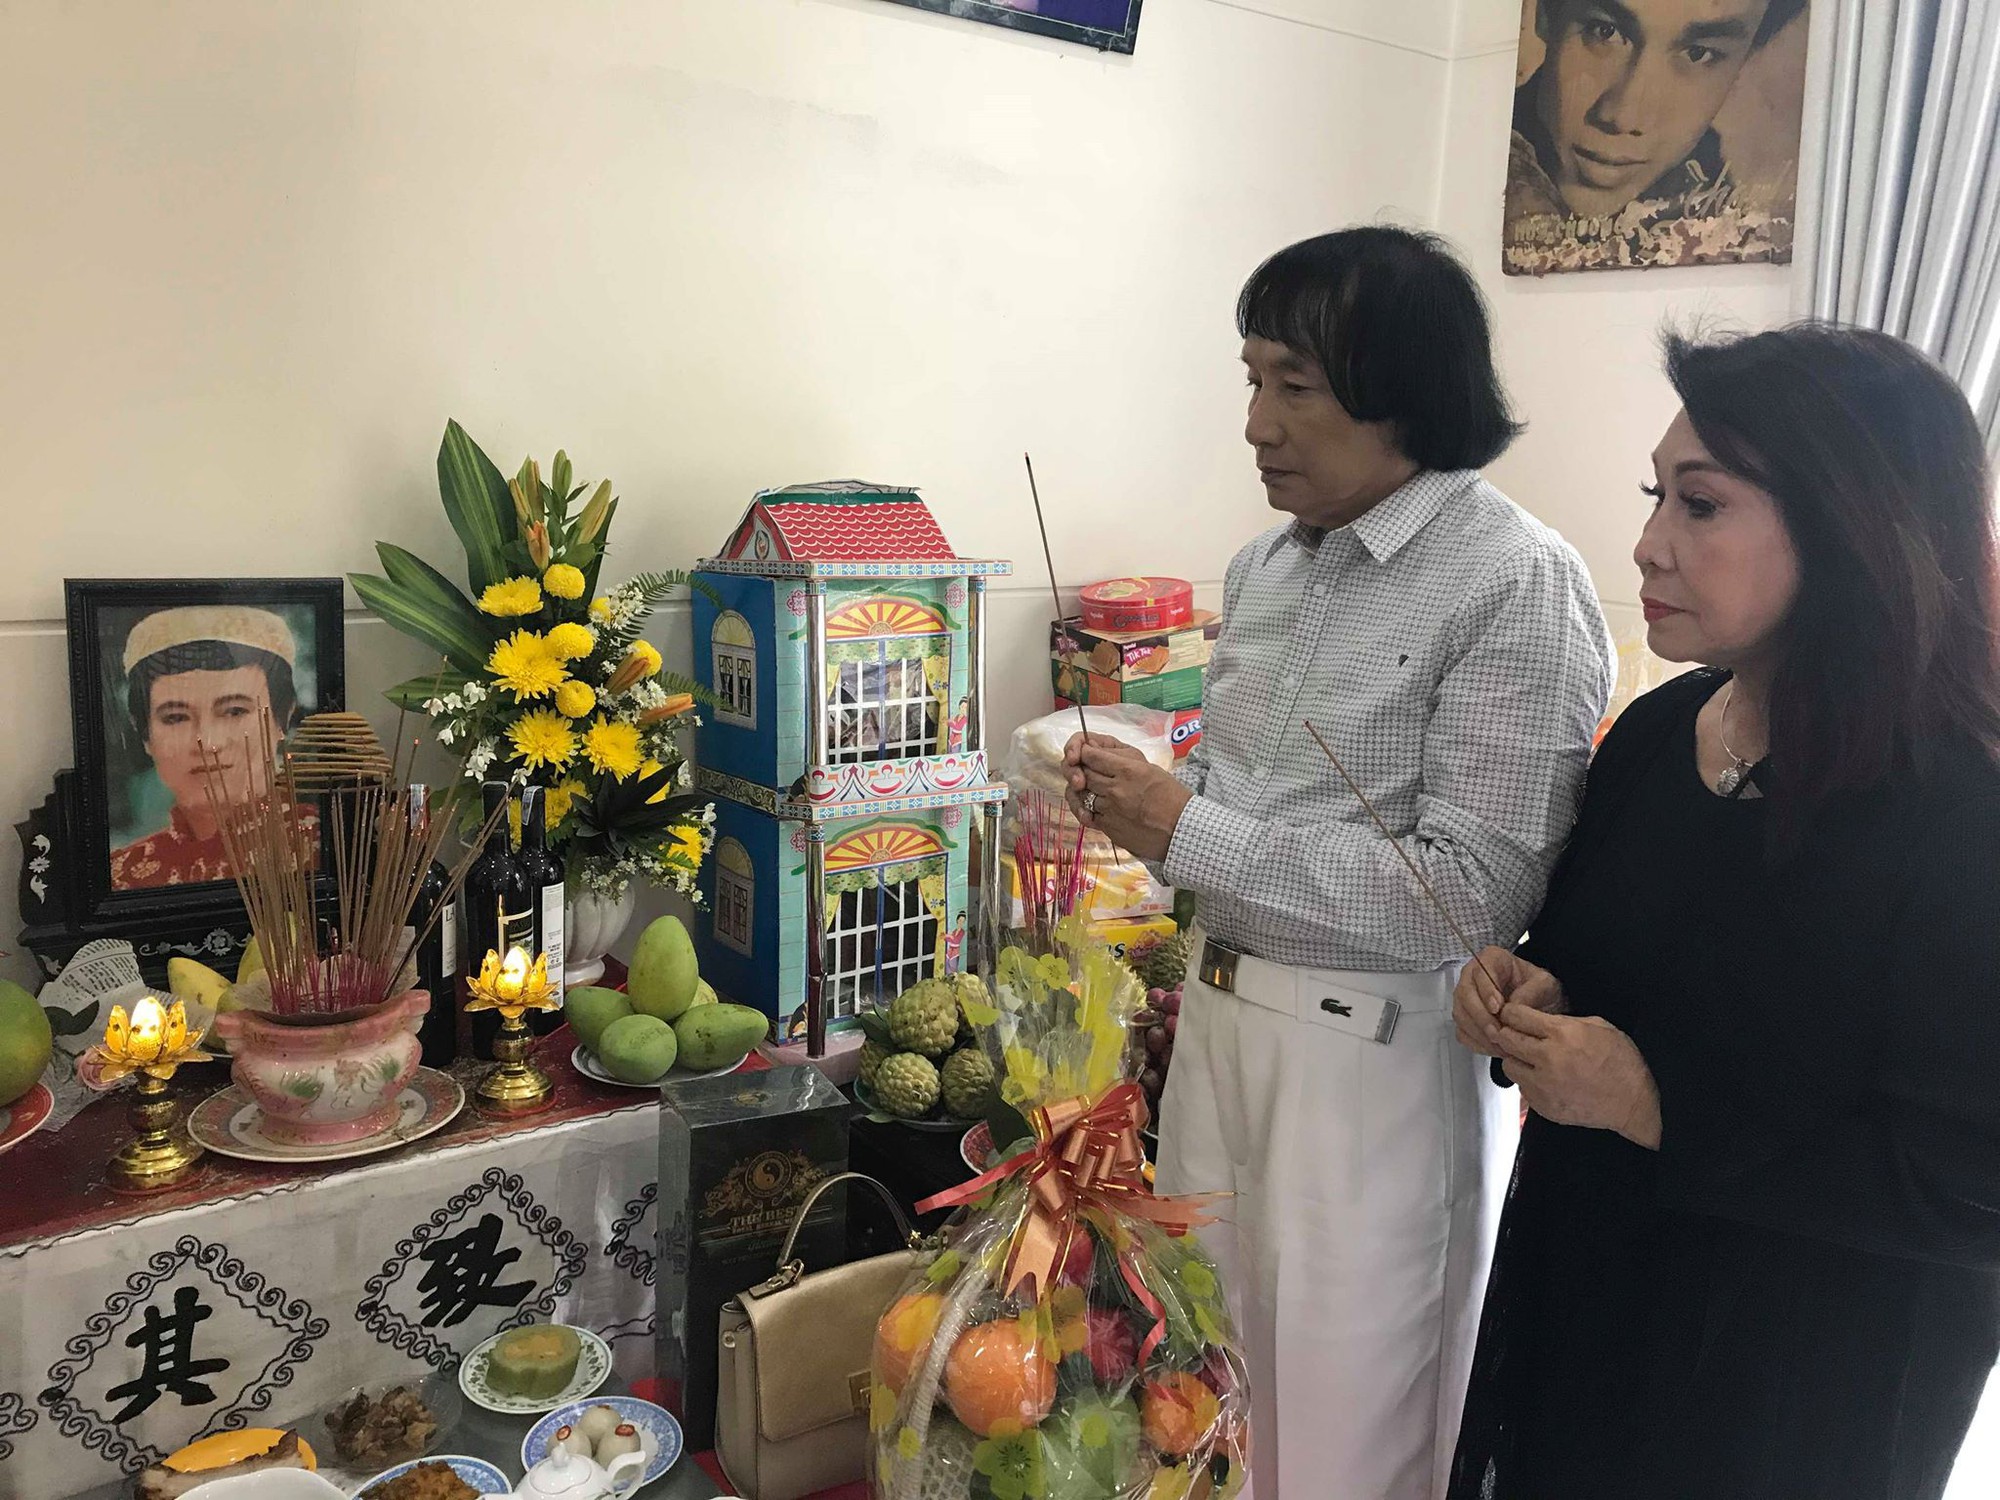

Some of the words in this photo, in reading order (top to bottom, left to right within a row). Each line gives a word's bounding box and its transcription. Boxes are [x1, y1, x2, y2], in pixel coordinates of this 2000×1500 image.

[1126, 650, 1141, 663] Tik
[1173, 718, 1203, 742] OR
[105, 1287, 230, 1425] 其
